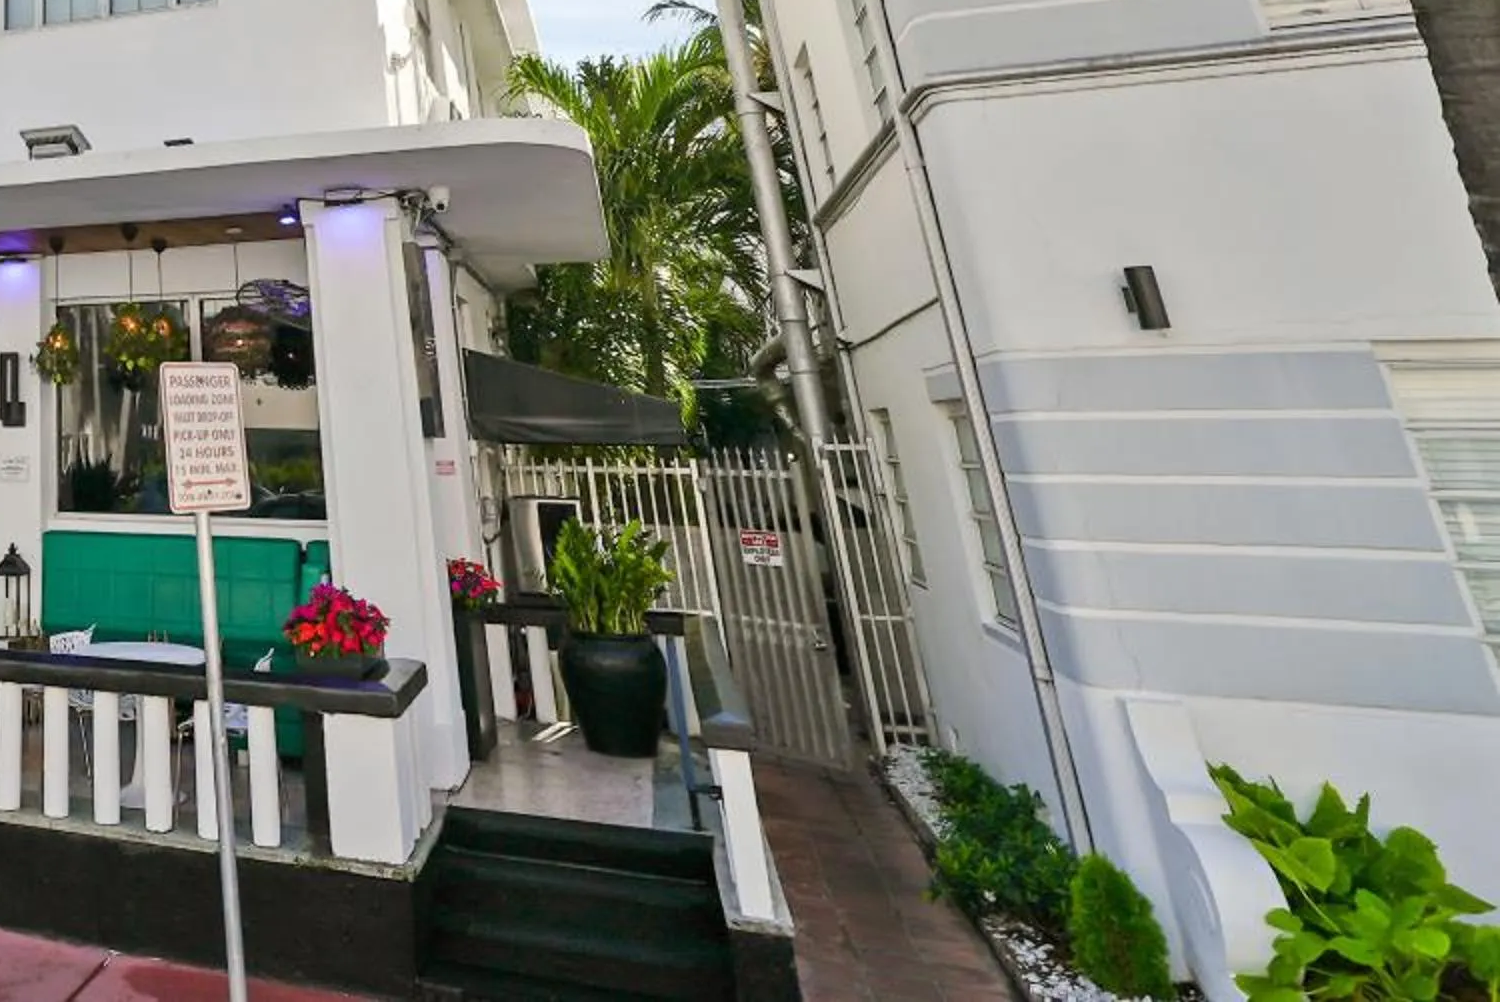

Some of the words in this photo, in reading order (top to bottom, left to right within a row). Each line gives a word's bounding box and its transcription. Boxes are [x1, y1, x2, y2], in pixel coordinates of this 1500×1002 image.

[169, 374, 231, 388] PASSENGER
[169, 393, 209, 406] LOADING
[211, 393, 236, 405] ZONE
[173, 429, 209, 442] PICK-UP
[211, 428, 235, 441] ONLY
[179, 447, 192, 459] 24
[195, 445, 235, 458] HOURS
[175, 463, 187, 476] 15
